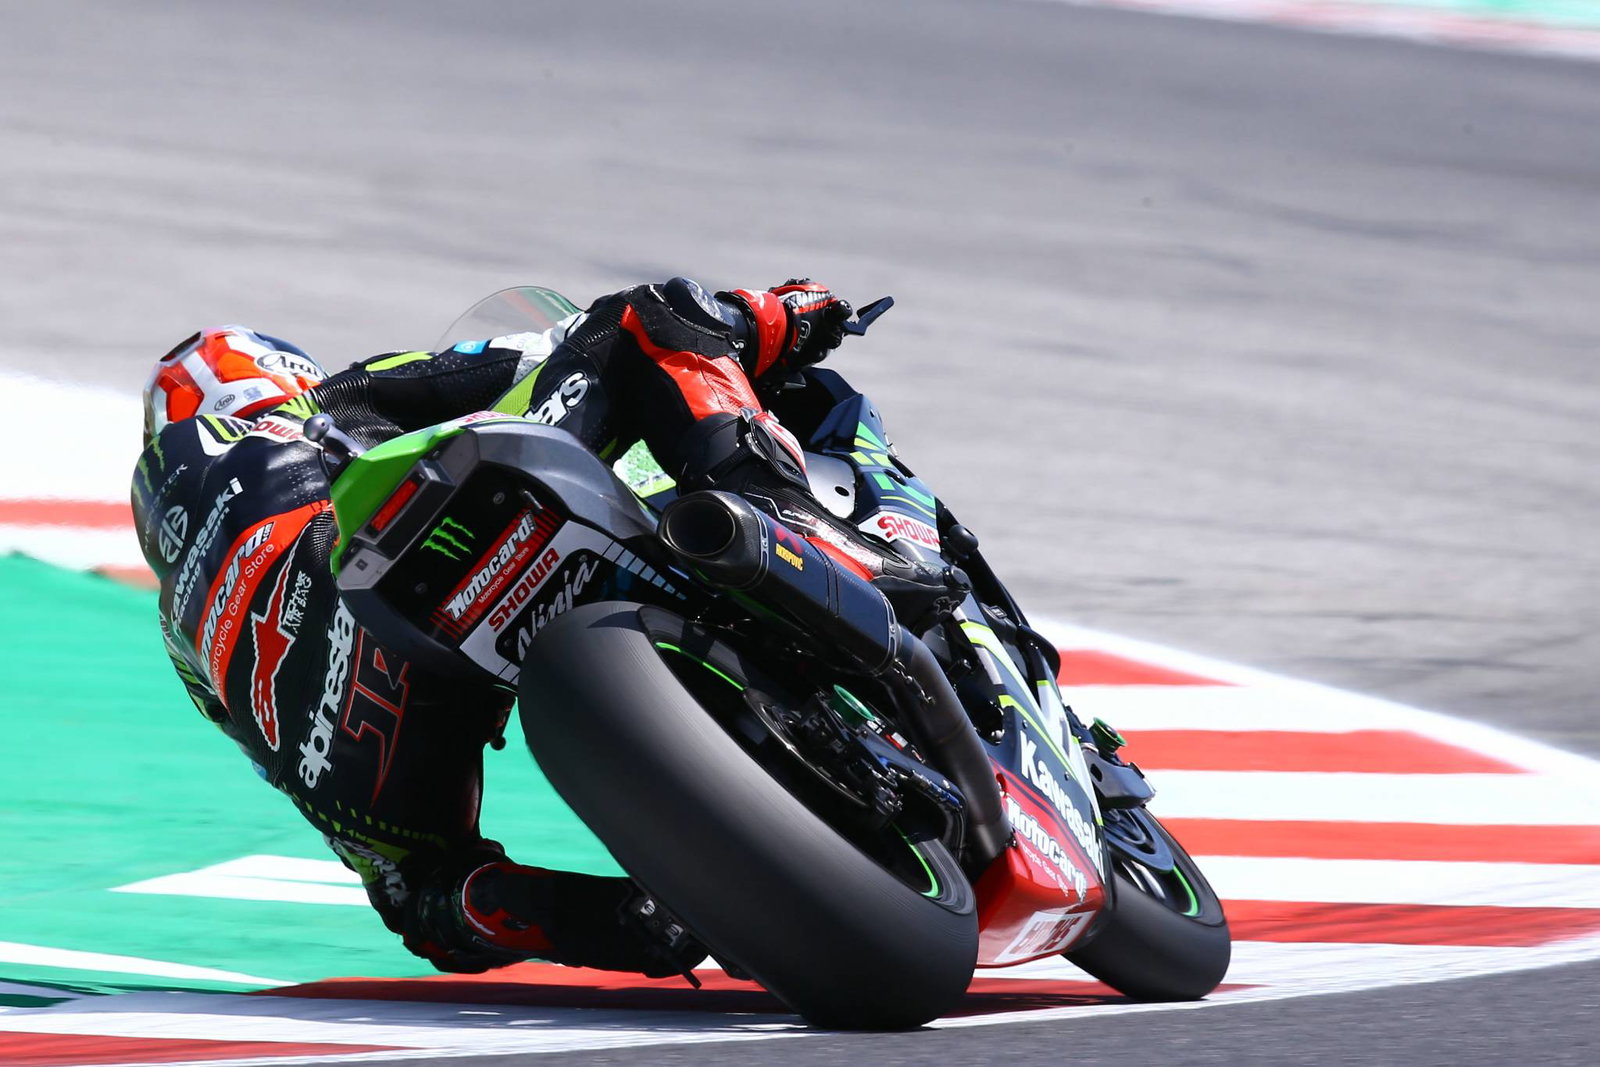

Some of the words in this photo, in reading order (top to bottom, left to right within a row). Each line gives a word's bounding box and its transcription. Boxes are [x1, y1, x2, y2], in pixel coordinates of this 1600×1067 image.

[257, 353, 321, 378] Arai
[216, 394, 235, 410] Arai
[252, 421, 304, 440] OWA
[199, 507, 230, 558] Team
[877, 515, 943, 547] SHOWA
[211, 619, 233, 691] torcycle
[228, 582, 248, 616] Gear
[244, 543, 275, 579] Store
[488, 547, 560, 632] SHOWA
[517, 560, 599, 661] Ninja
[298, 597, 356, 790] alpinesta
[1020, 730, 1106, 885] Kawasaki
